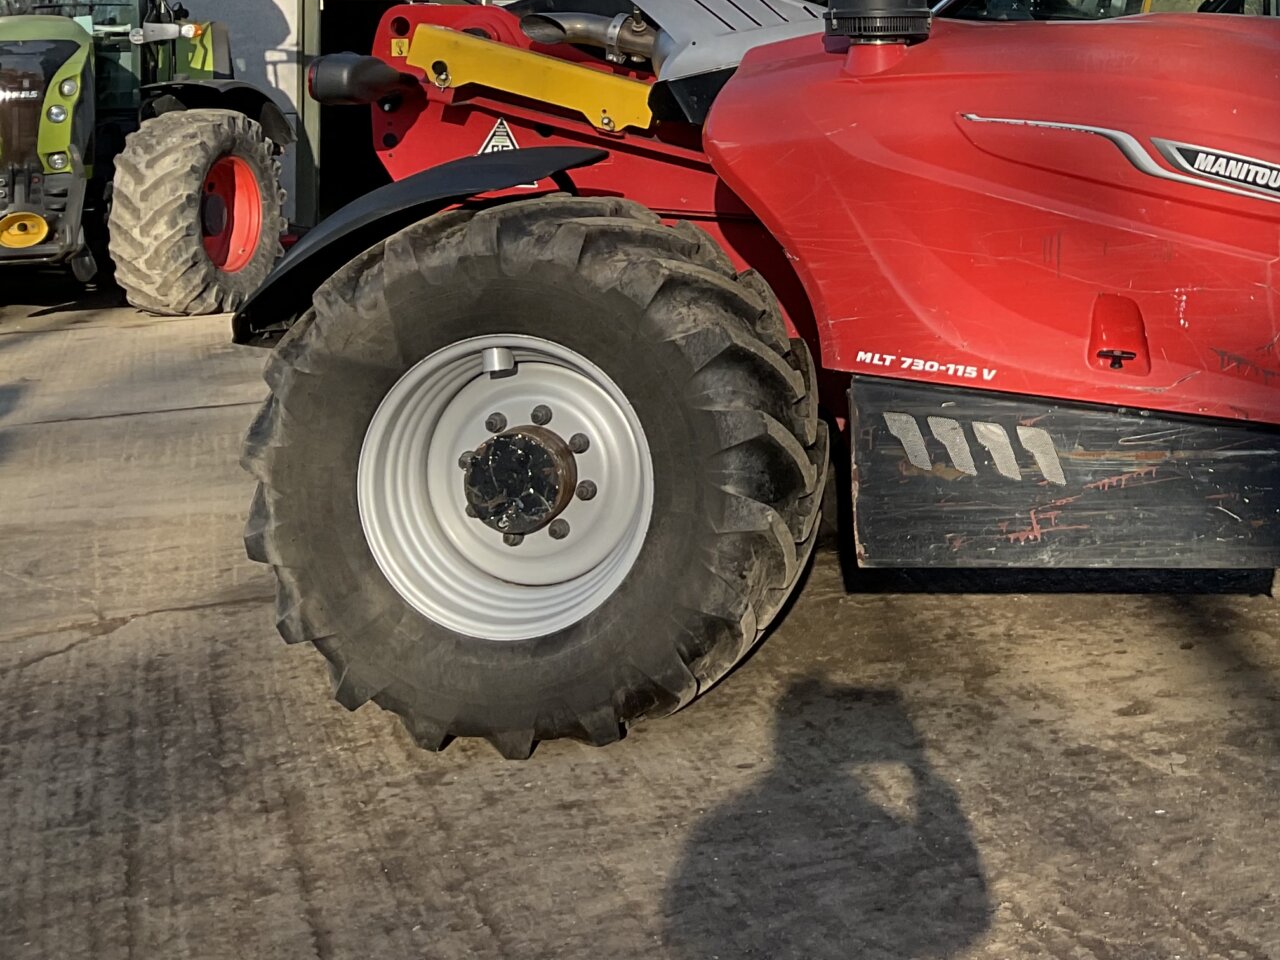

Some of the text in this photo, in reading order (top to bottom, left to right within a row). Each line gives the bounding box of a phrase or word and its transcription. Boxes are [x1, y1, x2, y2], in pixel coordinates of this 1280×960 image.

[856, 351, 998, 381] MLT 730-115 V
